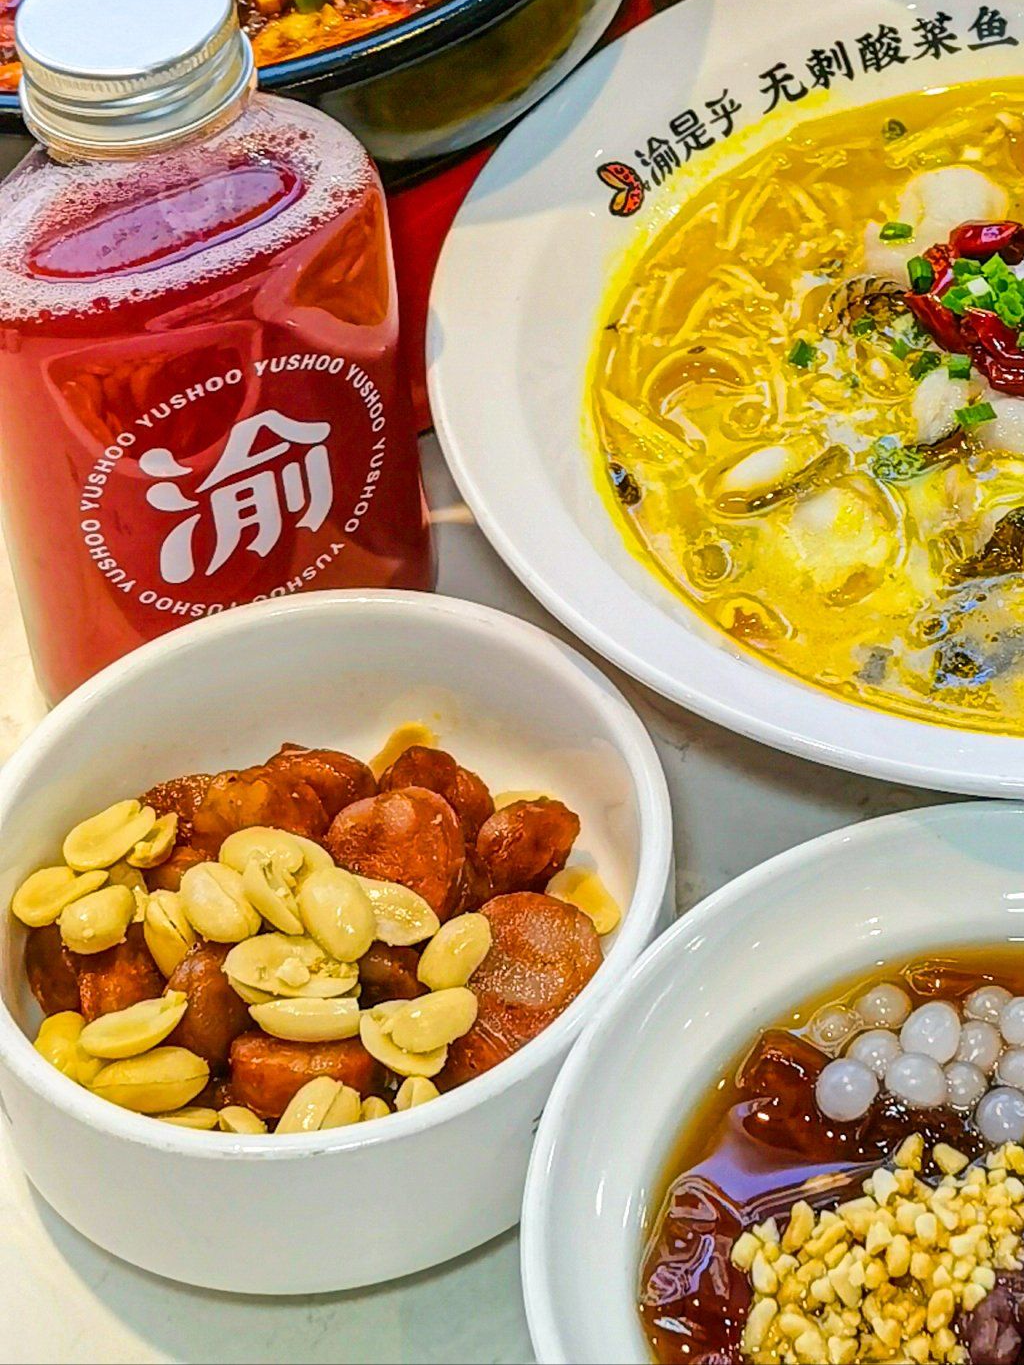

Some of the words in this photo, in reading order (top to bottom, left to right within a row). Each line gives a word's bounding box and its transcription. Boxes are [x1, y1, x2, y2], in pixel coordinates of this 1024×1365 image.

[634, 89, 743, 186] 渝是乎
[759, 6, 1020, 115] 无刺酸菜鱼
[135, 369, 242, 431] YUSHOO
[254, 354, 345, 377] YUSHOO
[345, 363, 386, 433] YUSHOO
[81, 432, 136, 512] YUSHOO
[138, 409, 334, 584] 渝
[344, 437, 387, 534] YUSHOO
[81, 519, 136, 594] YUSHOO
[139, 589, 237, 617] USHOO
